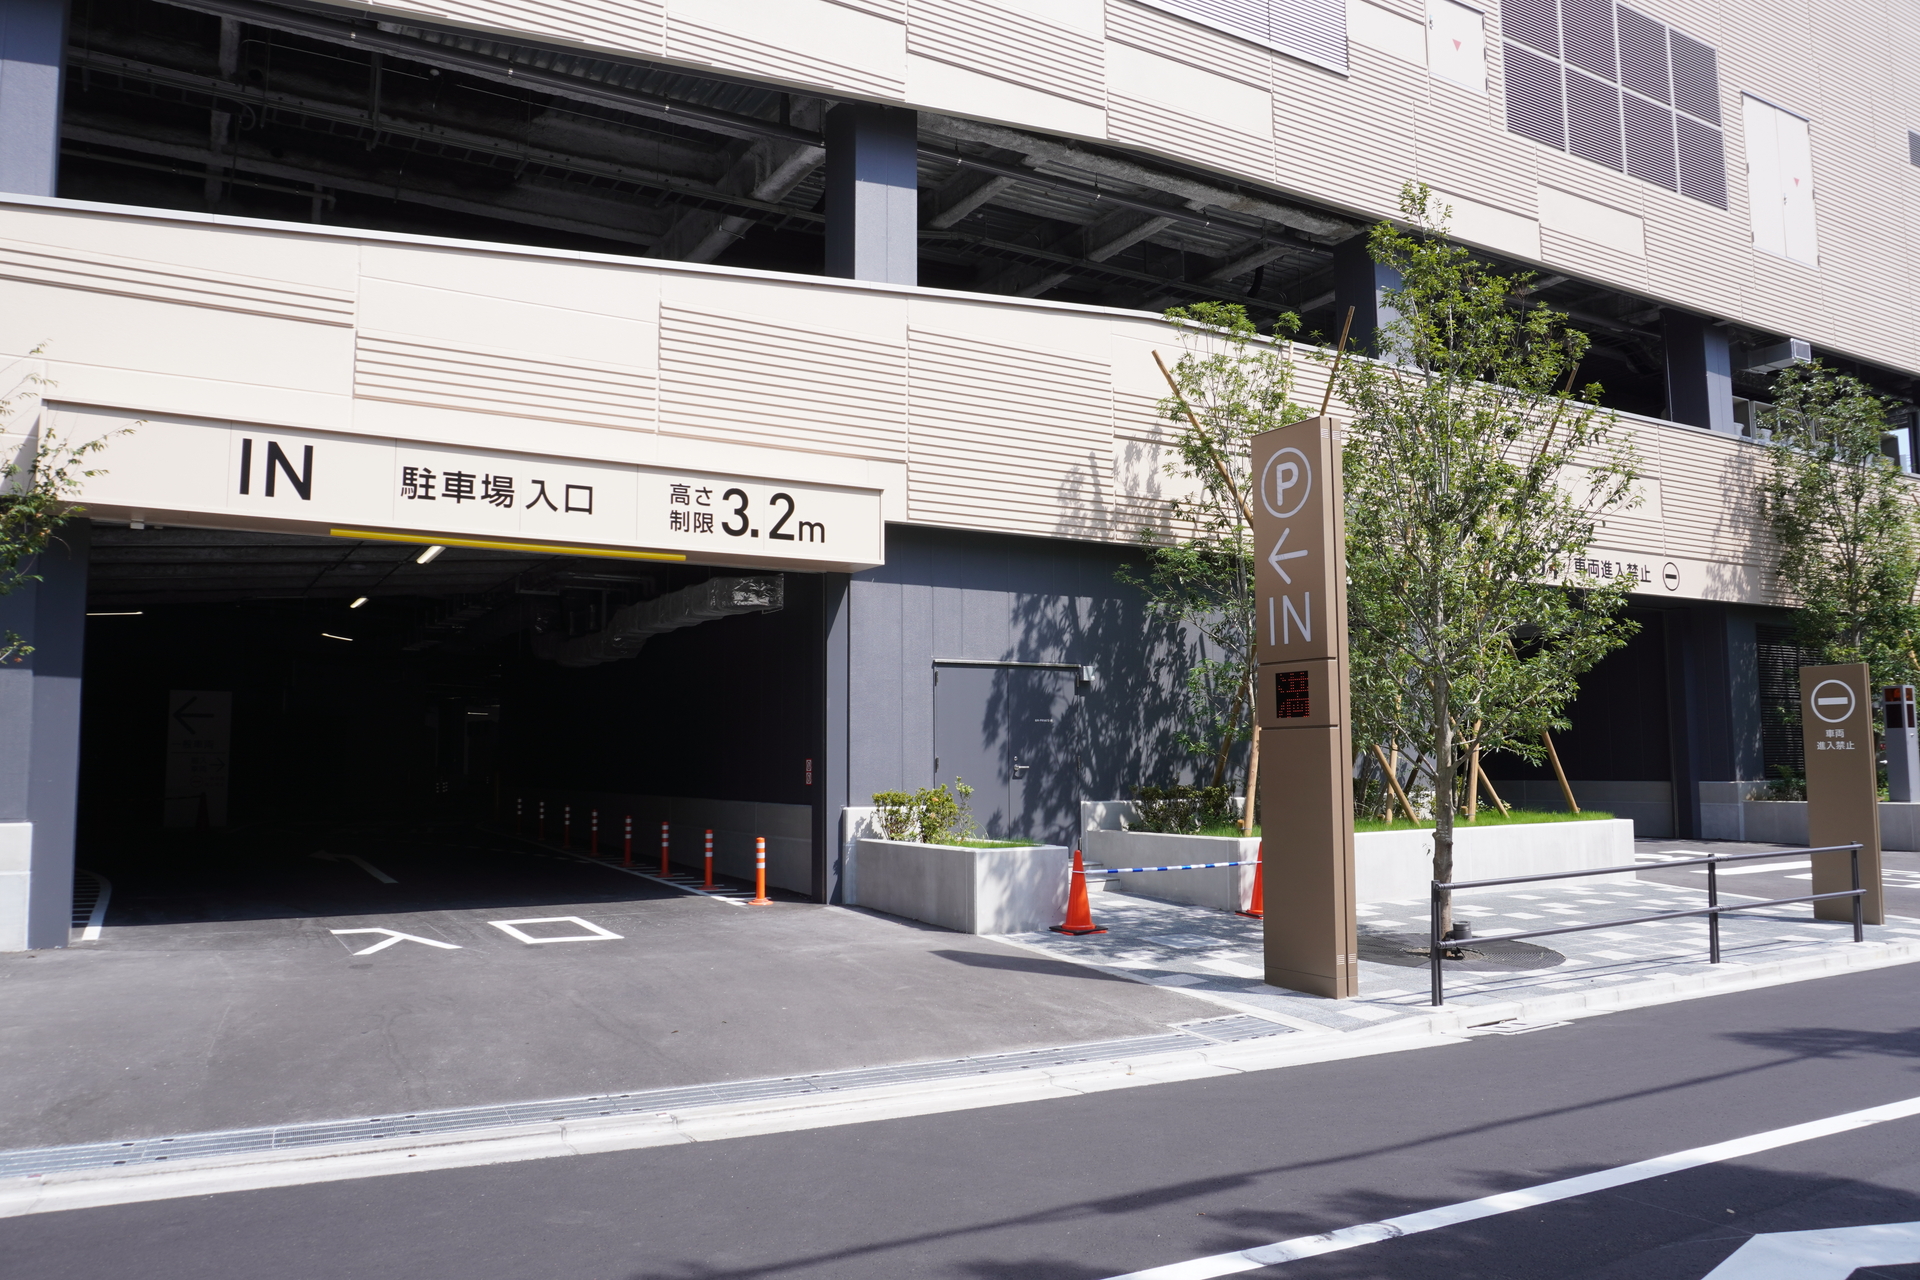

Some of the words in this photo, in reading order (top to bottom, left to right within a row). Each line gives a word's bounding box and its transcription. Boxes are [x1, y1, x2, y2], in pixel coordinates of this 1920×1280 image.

[239, 438, 314, 501] IN
[400, 465, 594, 515] 駐車場入口
[670, 483, 713, 507] 高さ
[669, 510, 714, 534] 制限
[722, 488, 826, 543] 3.2m
[1574, 557, 1652, 583] 車両進入禁止
[1269, 591, 1312, 646] IN
[1816, 740, 1855, 750] 進入禁止
[1825, 728, 1845, 738] 車両
[330, 916, 624, 956] 入口
